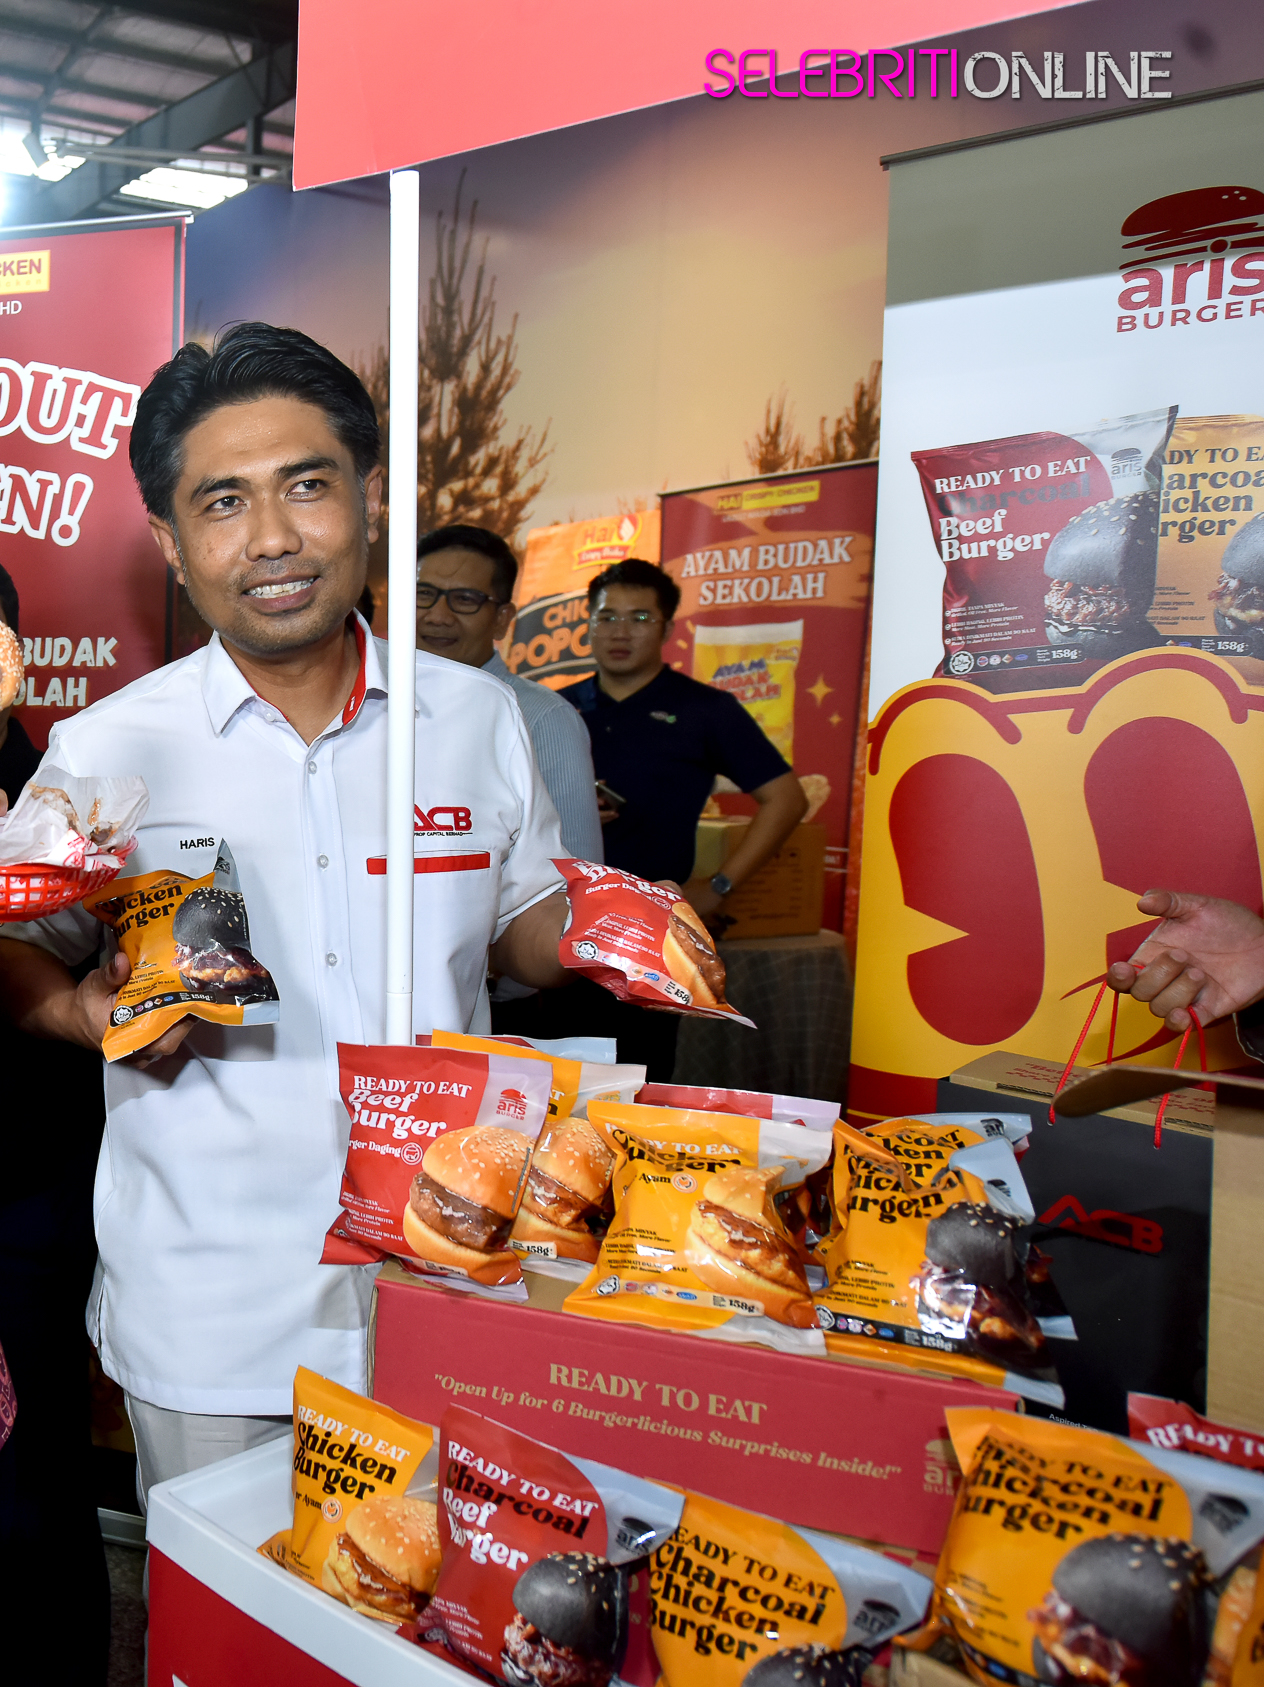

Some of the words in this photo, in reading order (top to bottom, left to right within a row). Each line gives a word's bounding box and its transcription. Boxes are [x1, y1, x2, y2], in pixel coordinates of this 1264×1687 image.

[1117, 246, 1264, 311] aris
[1116, 298, 1264, 333] BURGER
[1205, 447, 1240, 464] TO
[934, 469, 1004, 494] READY
[1009, 464, 1042, 482] TO
[1047, 456, 1091, 477] EAT
[937, 473, 1091, 516] Charcoal
[939, 509, 1008, 540] Beef
[681, 547, 752, 578] AYAM
[756, 536, 854, 571] BUDAK
[940, 532, 1051, 562] Burger
[699, 572, 826, 606] SEKOLAH
[1051, 648, 1078, 660] 158g
[1217, 641, 1244, 652] 158g
[180, 837, 215, 849] HARIS
[585, 883, 620, 894] Burger
[348, 1088, 419, 1112] Beef
[353, 1075, 410, 1093] READY
[414, 1081, 436, 1095] TO
[437, 1081, 472, 1098] EAT
[497, 1101, 526, 1116] aris
[368, 1140, 402, 1158] Daging
[671, 1142, 701, 1153] TO
[639, 1172, 671, 1184] Ayam
[1038, 1194, 1164, 1254] ACB
[526, 1245, 550, 1256] 158g
[728, 1299, 755, 1313] 158g
[549, 1363, 649, 1401] READY
[655, 1384, 700, 1412] TO
[708, 1393, 768, 1425] EAT
[297, 1404, 348, 1436] READY
[351, 1428, 373, 1447] TO
[374, 1438, 410, 1462] EAT
[434, 1373, 487, 1398] "Open
[491, 1385, 515, 1405] Up
[518, 1391, 548, 1409] for
[552, 1399, 564, 1413] 6
[568, 1401, 704, 1442] Burgerlicious
[707, 1429, 814, 1465] Surprises
[297, 1422, 397, 1485] Chicken
[293, 1447, 376, 1501] Burger
[447, 1440, 516, 1487] READY
[520, 1478, 551, 1501] TO
[552, 1492, 599, 1517] EAT
[1063, 1459, 1105, 1482] TO
[1113, 1473, 1174, 1496] EAT
[303, 1493, 322, 1511] Ayam
[443, 1487, 498, 1529] Beef
[446, 1461, 590, 1540] Charcoal
[655, 1542, 827, 1627] Charcoal
[742, 1555, 779, 1582] TO
[783, 1572, 836, 1602] EAT
[650, 1570, 780, 1641] Chicken
